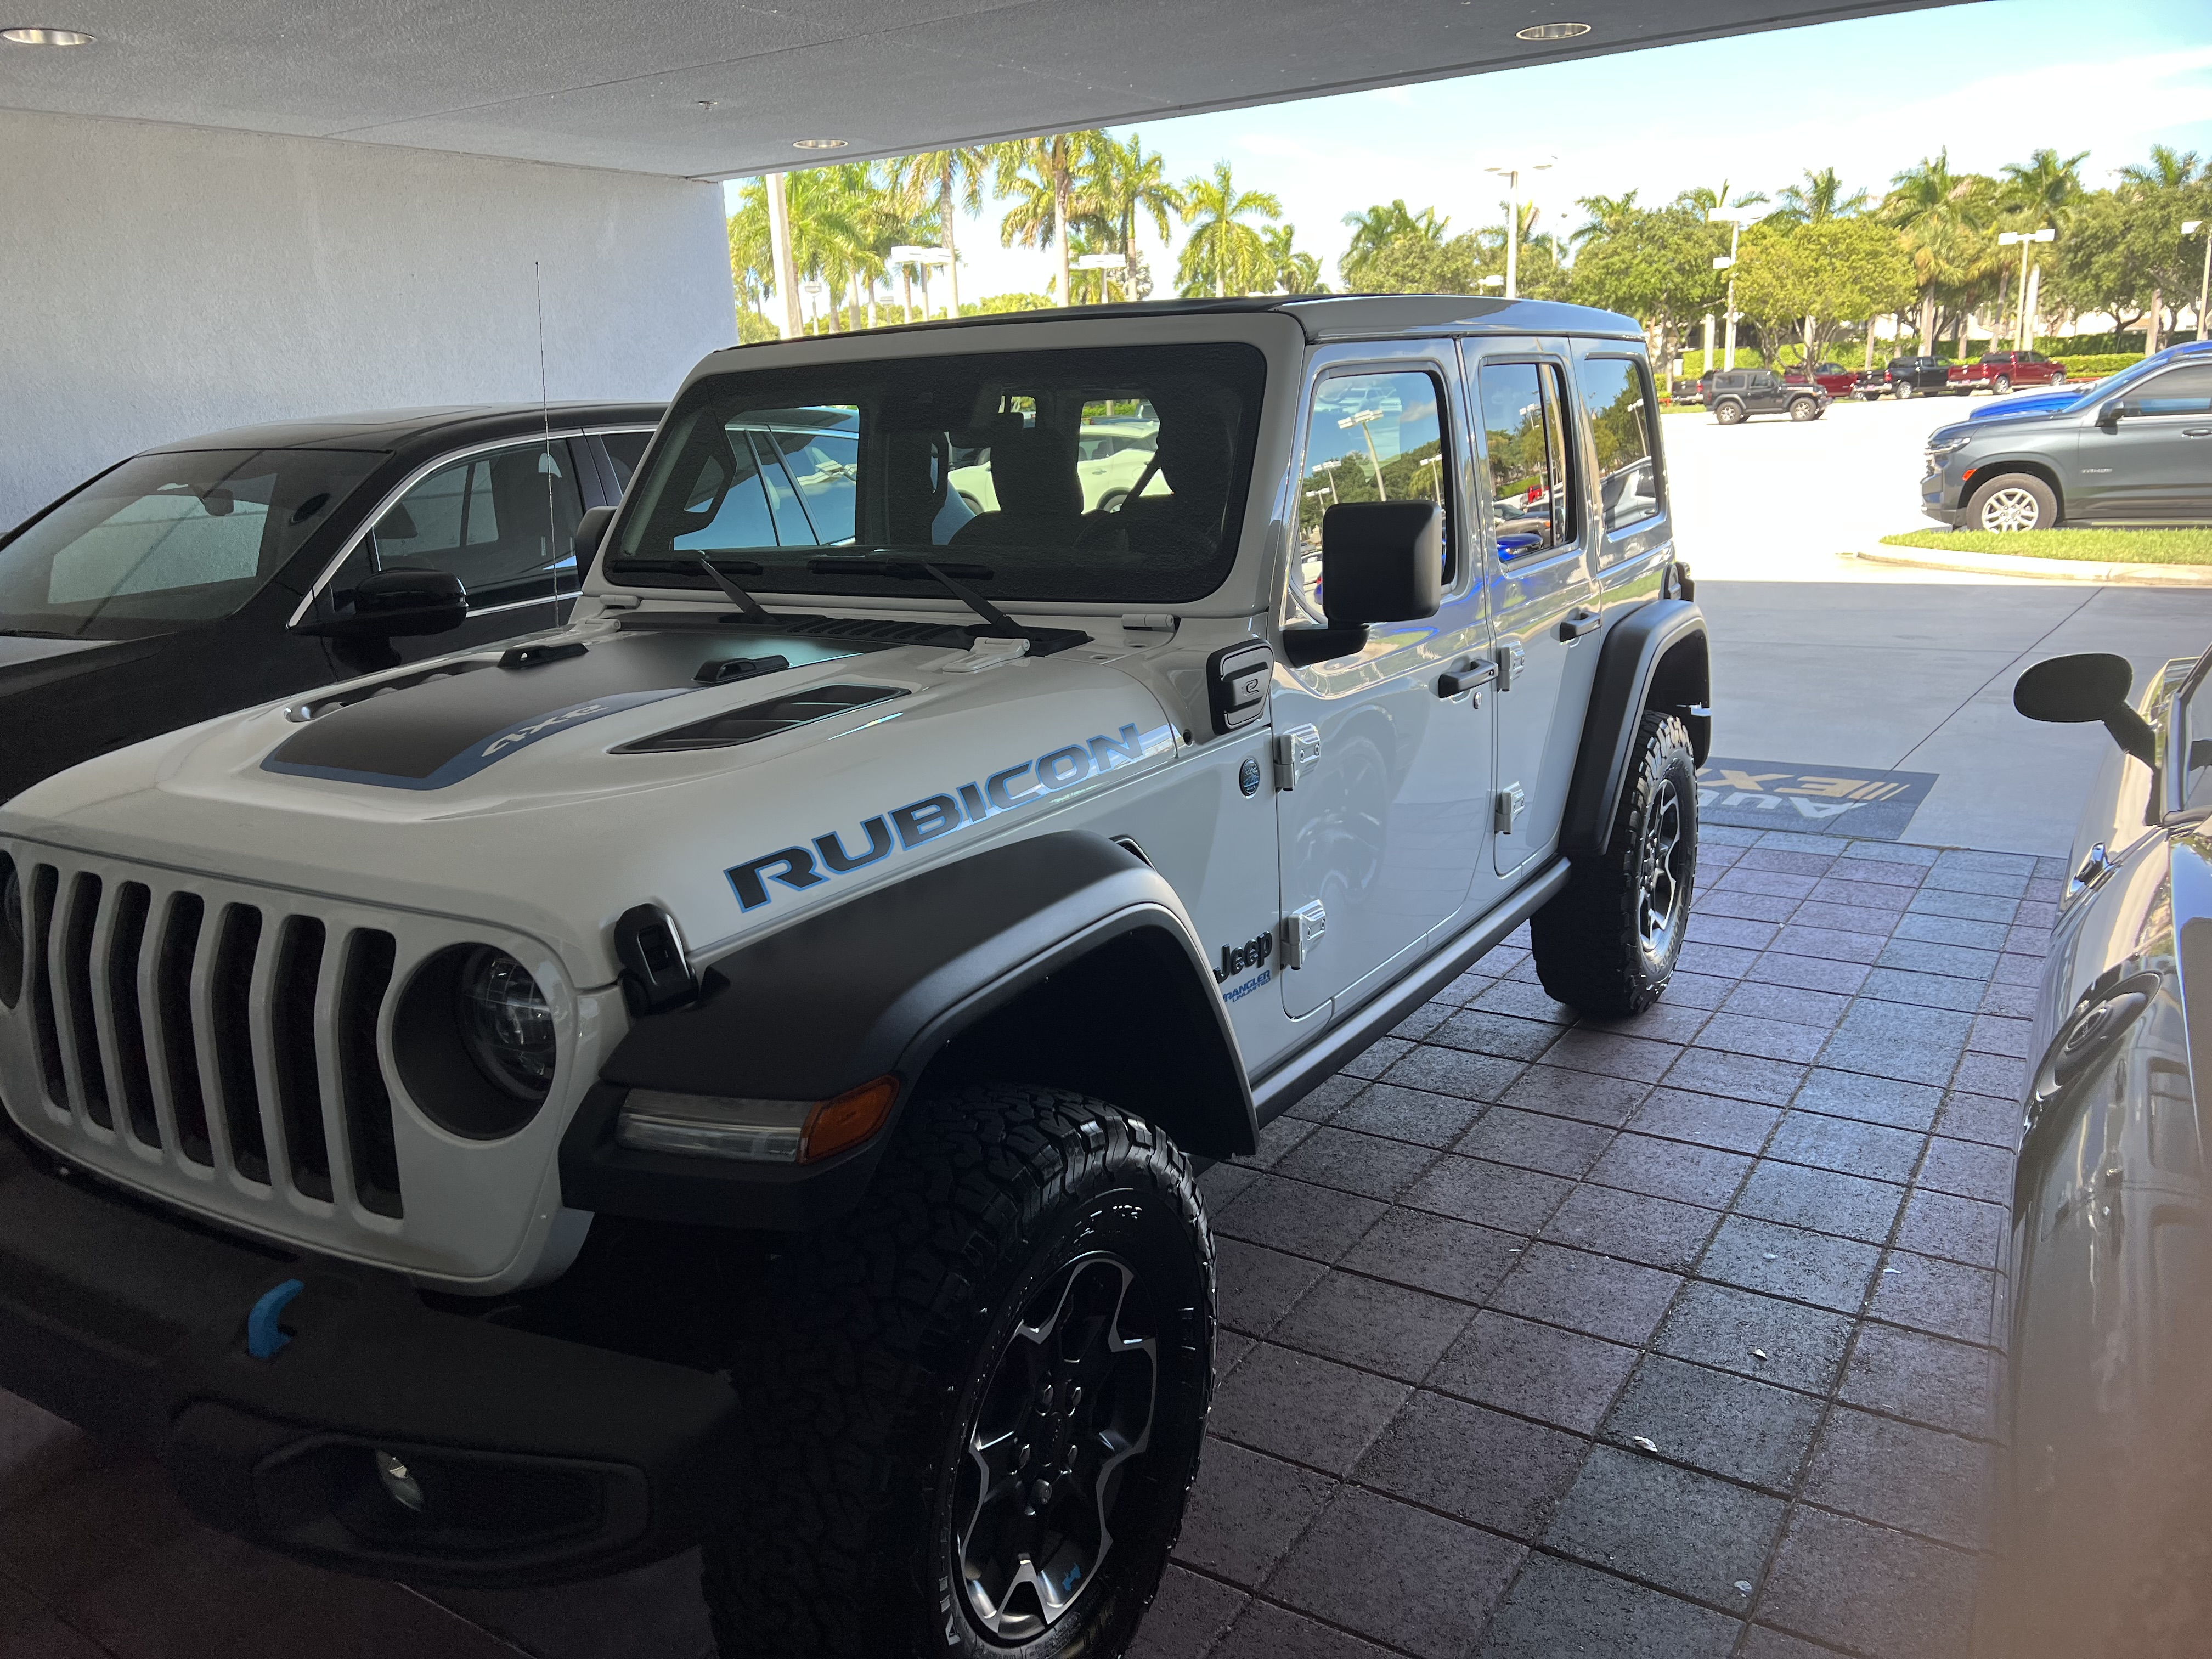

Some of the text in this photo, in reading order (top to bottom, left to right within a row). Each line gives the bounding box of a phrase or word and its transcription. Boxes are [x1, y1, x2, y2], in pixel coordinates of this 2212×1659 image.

[723, 722, 1146, 913] RUBICON
[1213, 930, 1273, 984] Jeep
[1223, 969, 1271, 1003] RANGLER
[1232, 977, 1271, 1003] UNLIMITED
